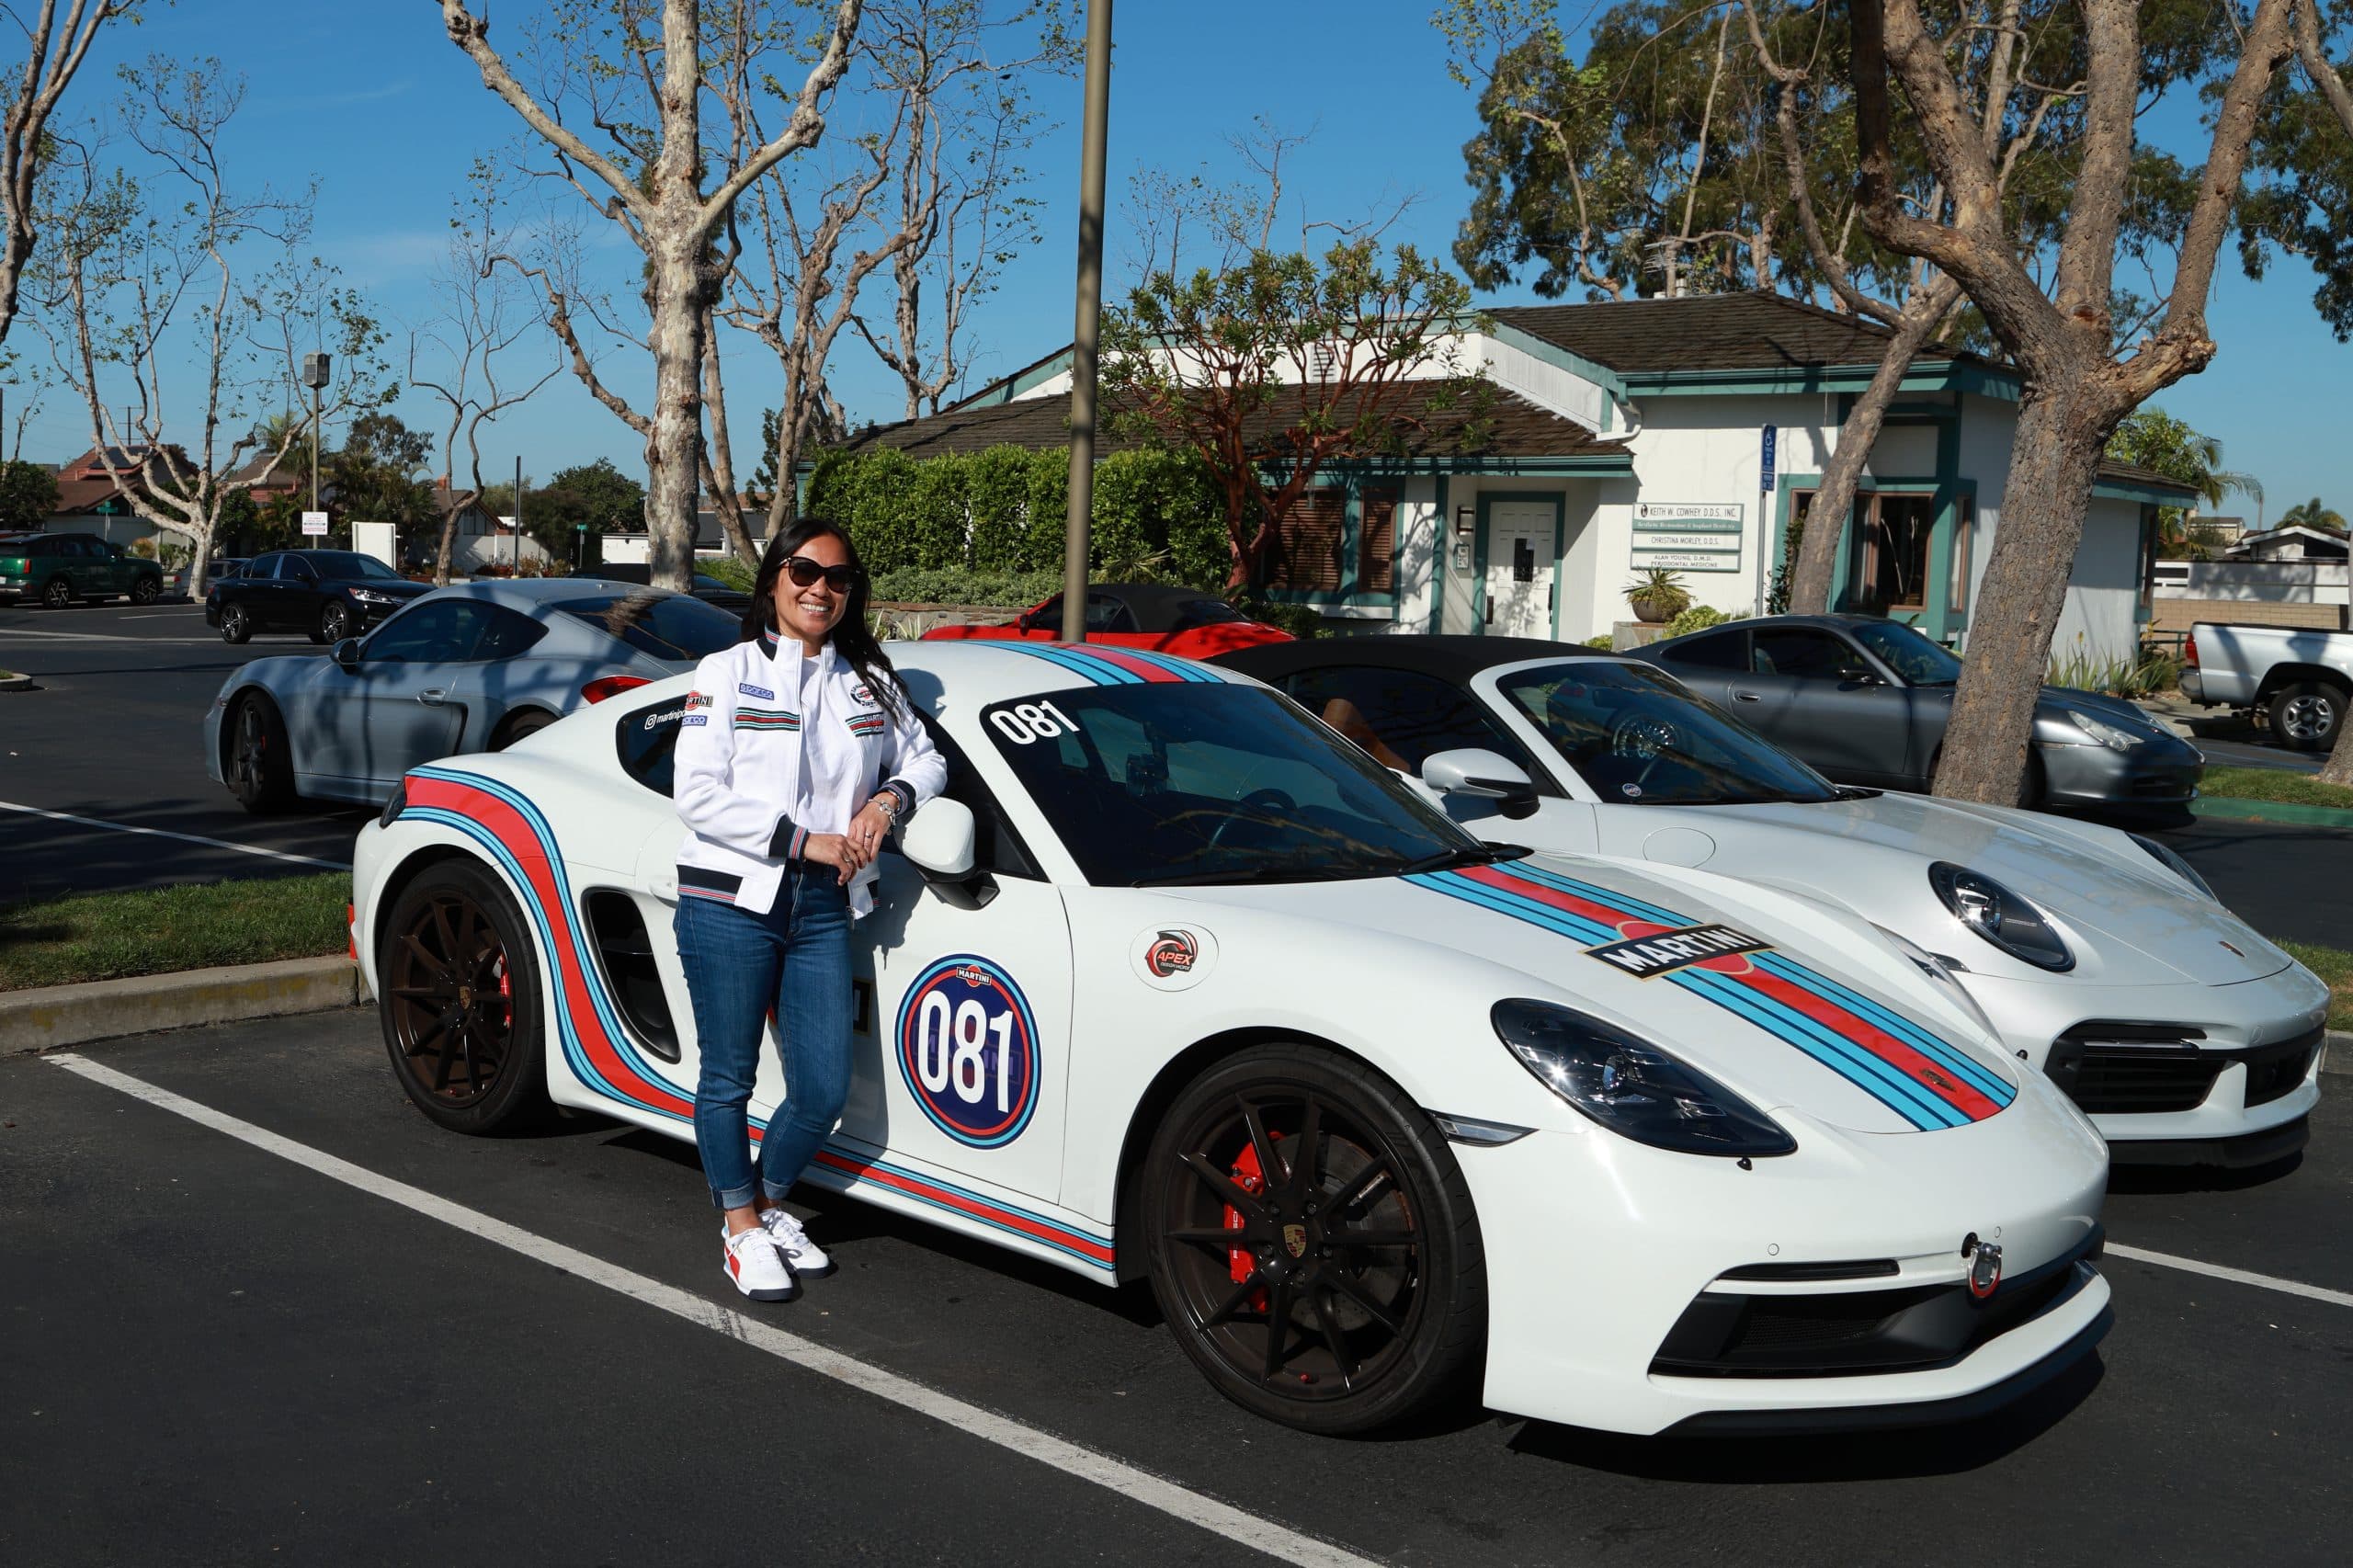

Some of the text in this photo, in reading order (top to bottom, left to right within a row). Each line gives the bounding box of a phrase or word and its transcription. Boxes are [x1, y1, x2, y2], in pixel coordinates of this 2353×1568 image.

[1650, 507, 1665, 517] KEITH
[989, 699, 1081, 745] 081
[1157, 951, 1193, 966] APEX
[1602, 927, 1760, 971] MARTINI
[958, 968, 991, 984] MARTINI
[917, 990, 1014, 1113] 081
